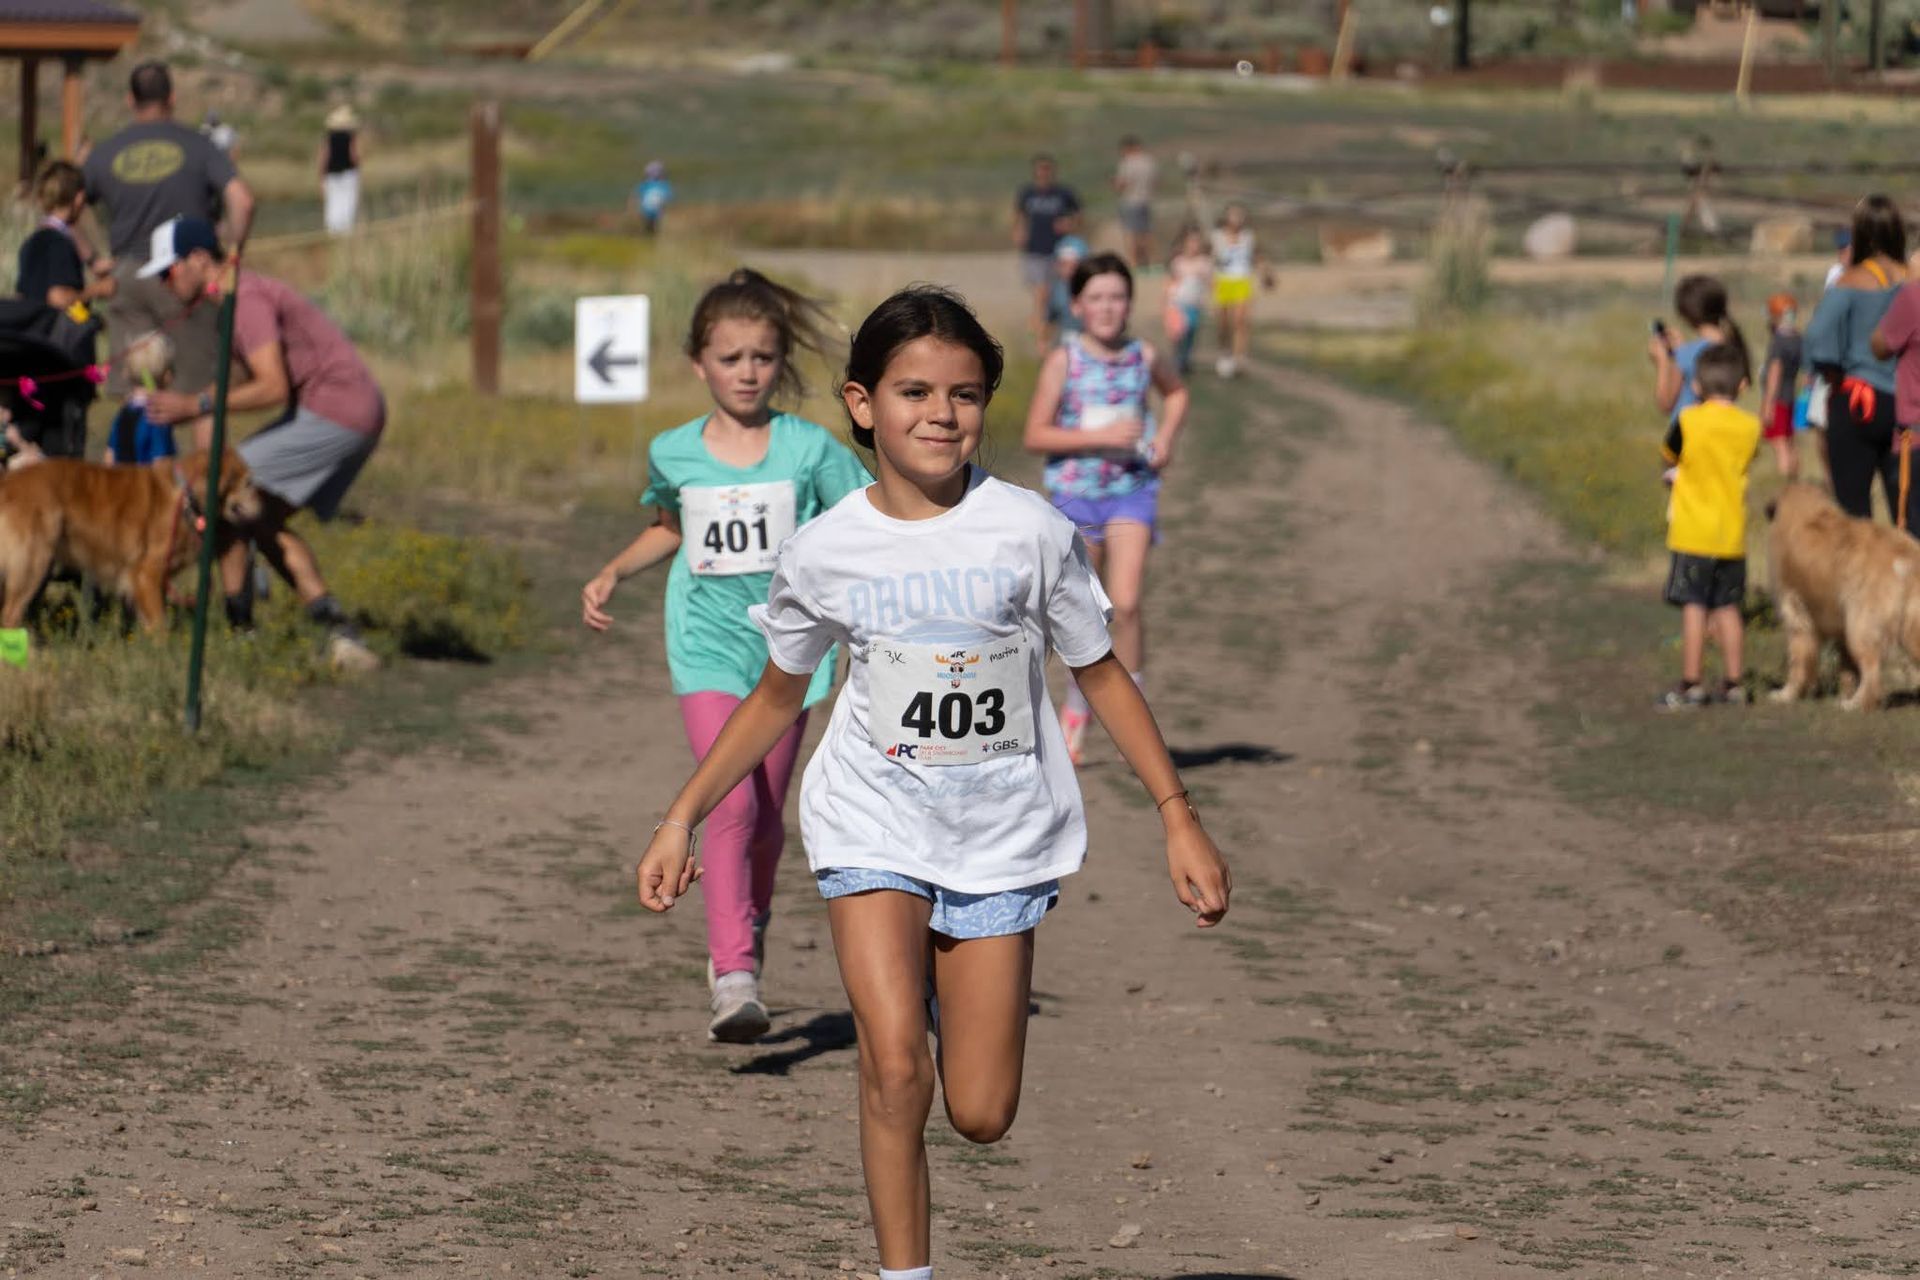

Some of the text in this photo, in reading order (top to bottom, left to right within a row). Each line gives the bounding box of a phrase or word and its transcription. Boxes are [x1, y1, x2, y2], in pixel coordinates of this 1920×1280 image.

[703, 518, 768, 553] 401
[884, 650, 906, 664] 3K
[901, 688, 1006, 739] 403
[897, 743, 918, 759] PC
[992, 738, 1019, 751] GBS
